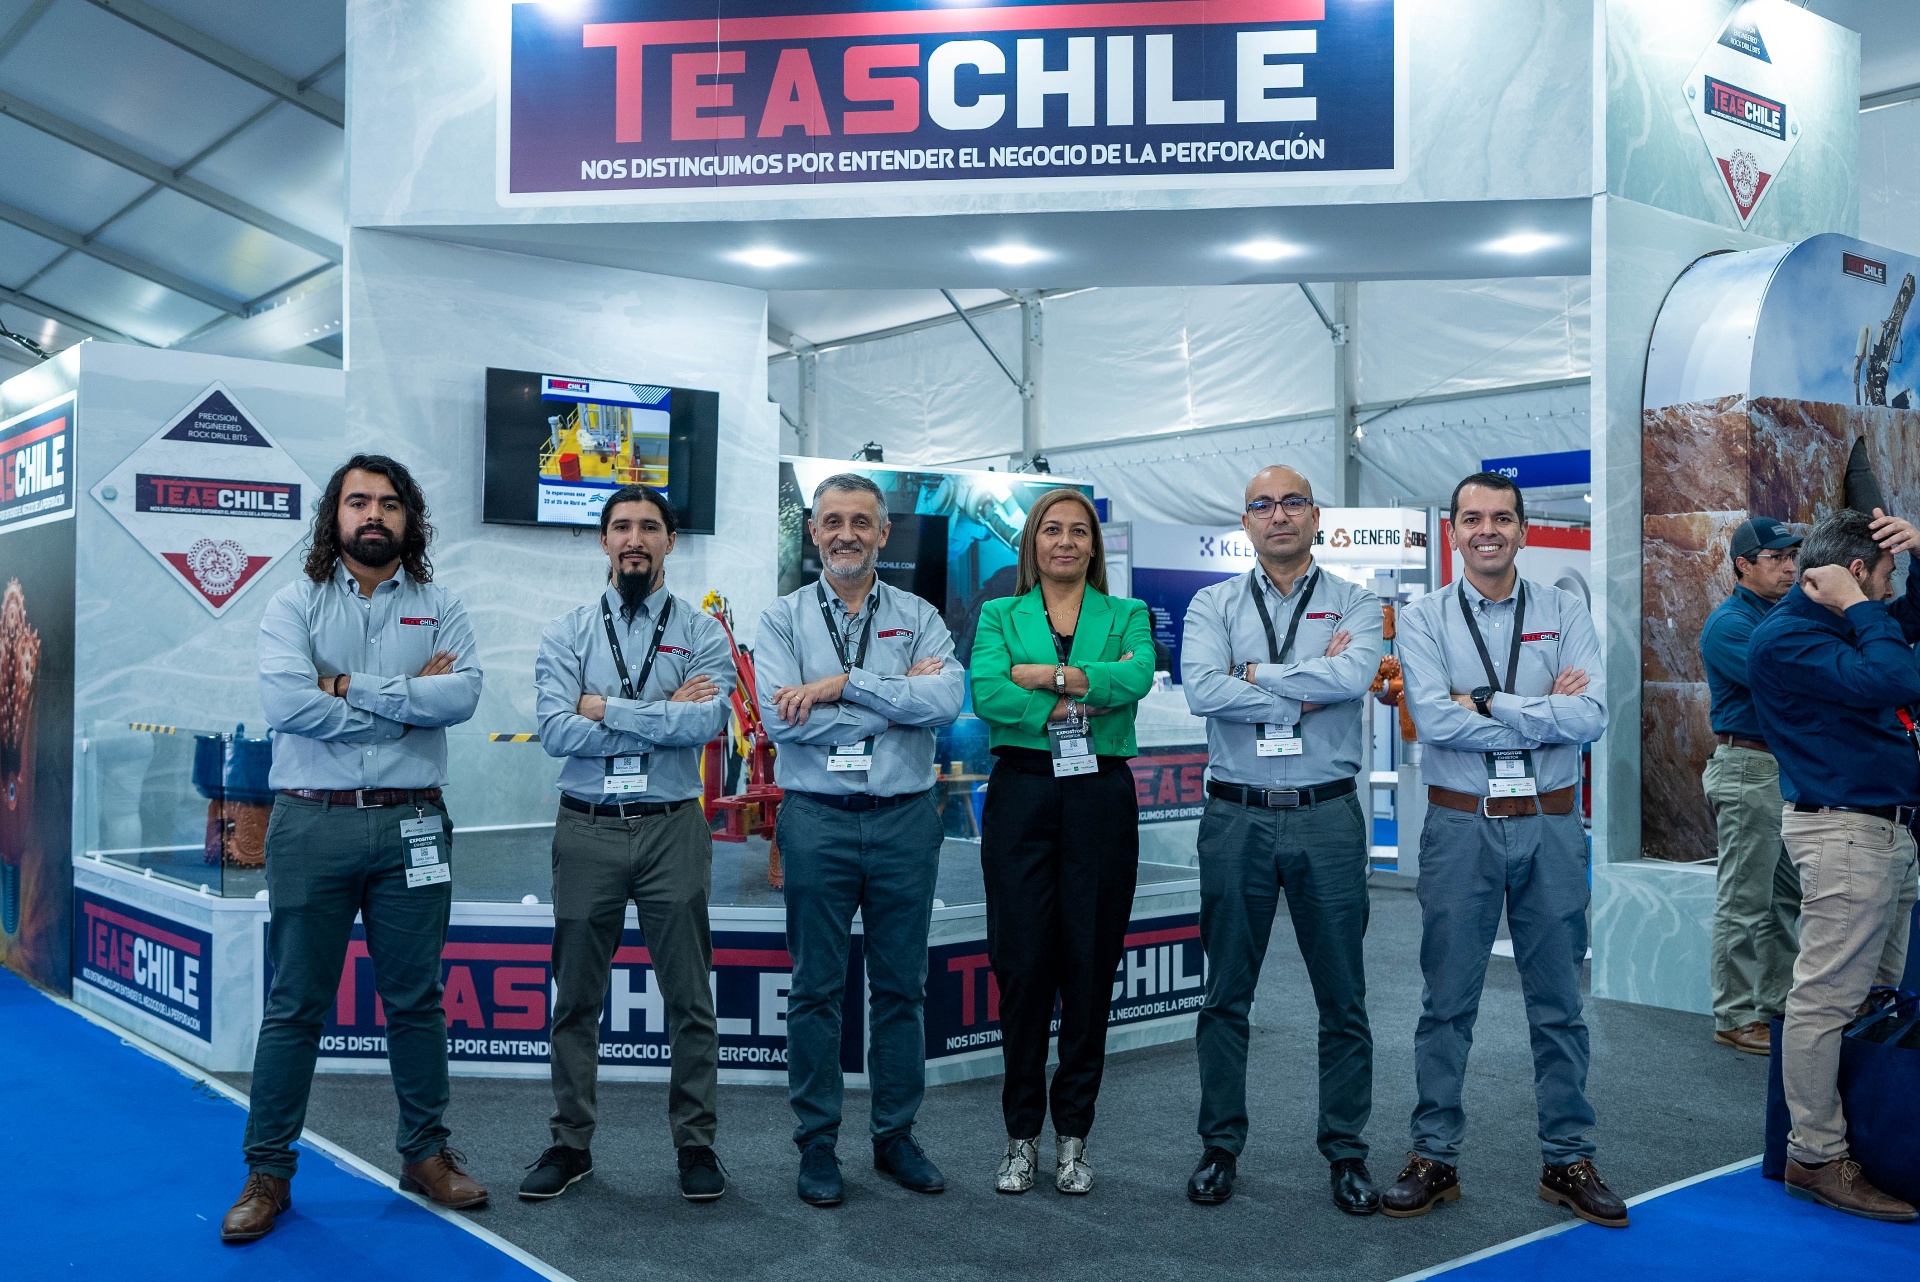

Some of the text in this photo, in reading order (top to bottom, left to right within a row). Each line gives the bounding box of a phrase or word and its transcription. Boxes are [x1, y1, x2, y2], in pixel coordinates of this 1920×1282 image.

[583, 0, 1325, 143] TEASCHILE
[1711, 81, 1781, 131] TEASCHILE
[581, 131, 1326, 180] NOS DISTINGUIMOS POR ENTENDER EL NEGOCIO DE LA PERFORACIÓN
[194, 421, 242, 432] ENGINEERED
[198, 412, 238, 422] PRECISION
[188, 430, 248, 441] ROCK DRILL BITS
[150, 479, 290, 511] TEASCHILE
[1353, 529, 1400, 545] CENERG
[875, 561, 916, 569] ASCHILE.COM
[1180, 806, 1204, 816] ENTEND
[83, 901, 201, 1011] TEASCHILE
[946, 1032, 968, 1050] NOS
[970, 1029, 1003, 1046] DISTIN
[1117, 1003, 1154, 1020] NEGOCIO
[1154, 1001, 1165, 1014] DE
[1166, 999, 1178, 1012] LA
[1178, 994, 1207, 1010] PERFO
[455, 1039, 488, 1055] POR
[490, 1040, 551, 1056] ENTEND
[718, 1046, 788, 1063] ERFORAC
